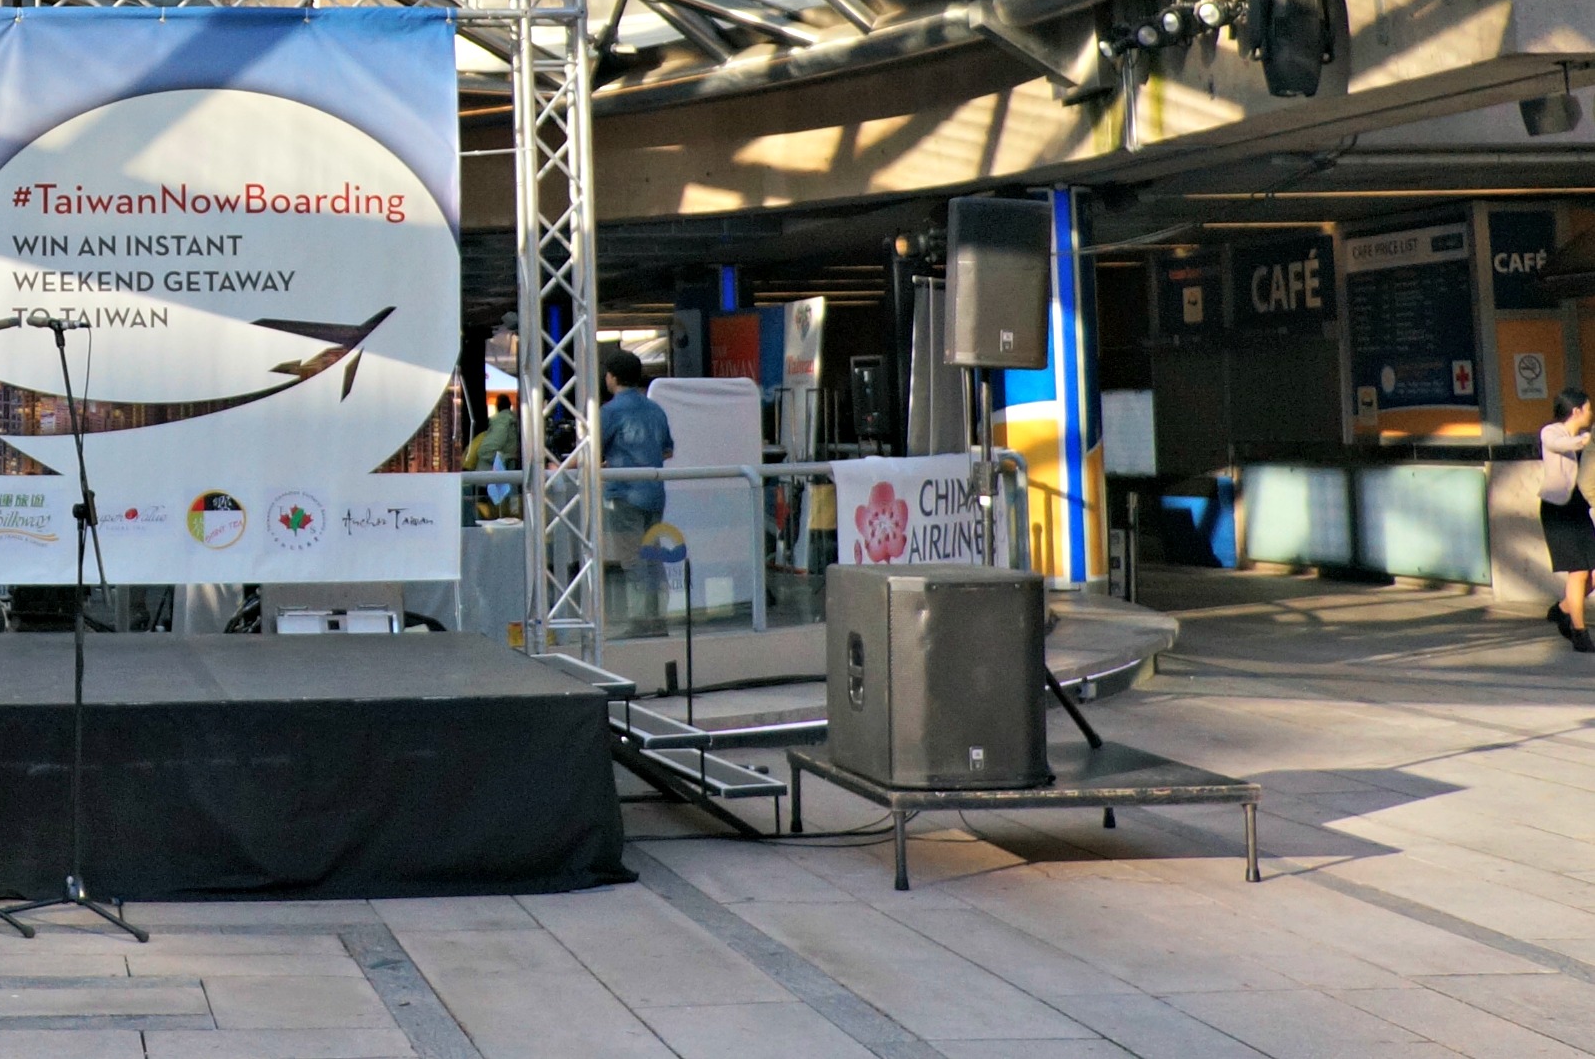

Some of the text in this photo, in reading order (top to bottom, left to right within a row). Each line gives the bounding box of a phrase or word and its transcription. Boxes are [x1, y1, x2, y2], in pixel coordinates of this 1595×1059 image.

[12, 182, 406, 224] #TaiwanNowBoarding
[12, 235, 244, 257] WIN AN INSTANT
[12, 271, 296, 293] WEEKEND GETAWAY
[1251, 248, 1321, 313] CAFÉ
[59, 307, 169, 328] TAIWAN
[909, 520, 996, 563] AIRLINE
